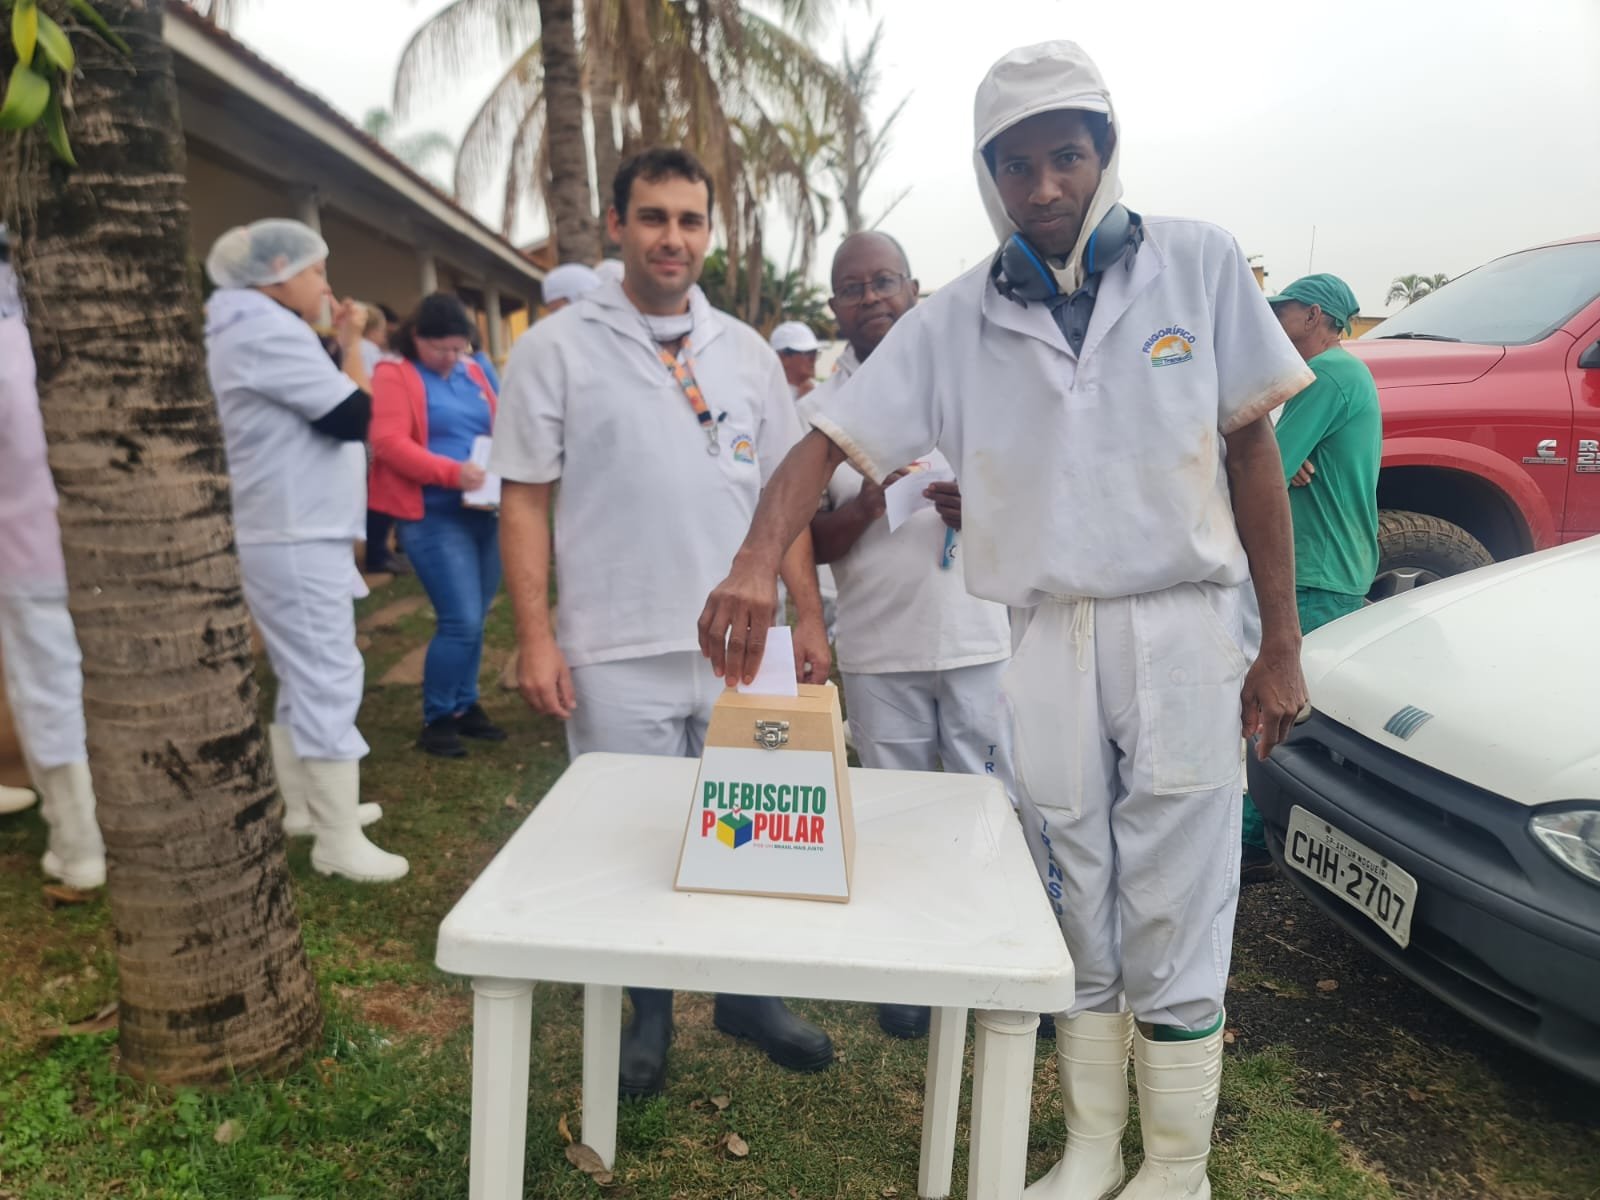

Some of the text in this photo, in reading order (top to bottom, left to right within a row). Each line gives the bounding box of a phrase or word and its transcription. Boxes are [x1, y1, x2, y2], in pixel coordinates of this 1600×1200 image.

[1142, 324, 1196, 353] FRIGORÍFICO
[703, 781, 826, 814] PLEBISCITO
[701, 810, 825, 846] PPULAR
